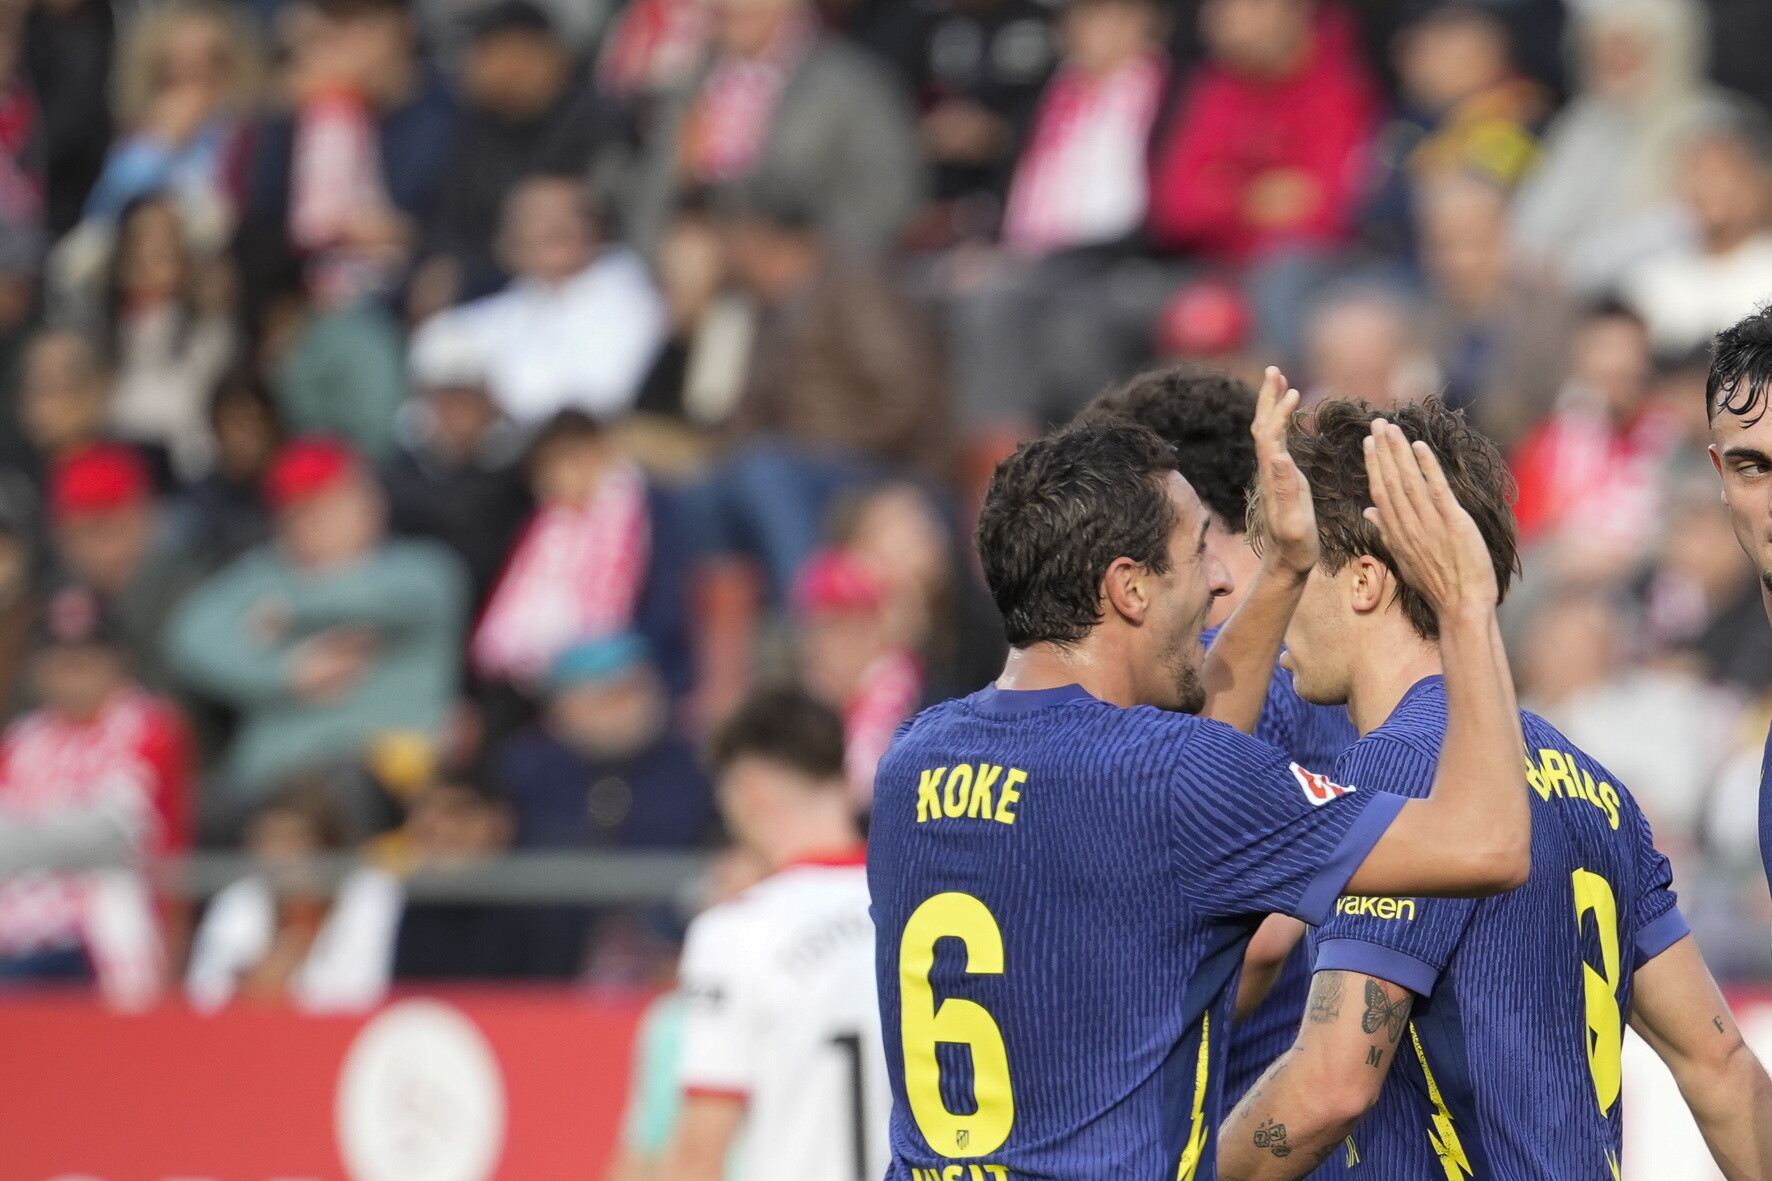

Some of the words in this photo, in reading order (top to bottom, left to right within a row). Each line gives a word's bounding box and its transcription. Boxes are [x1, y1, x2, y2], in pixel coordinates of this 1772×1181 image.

[916, 763, 1028, 825] KOKE
[1336, 895, 1416, 921] raken
[899, 891, 1014, 1158] 6
